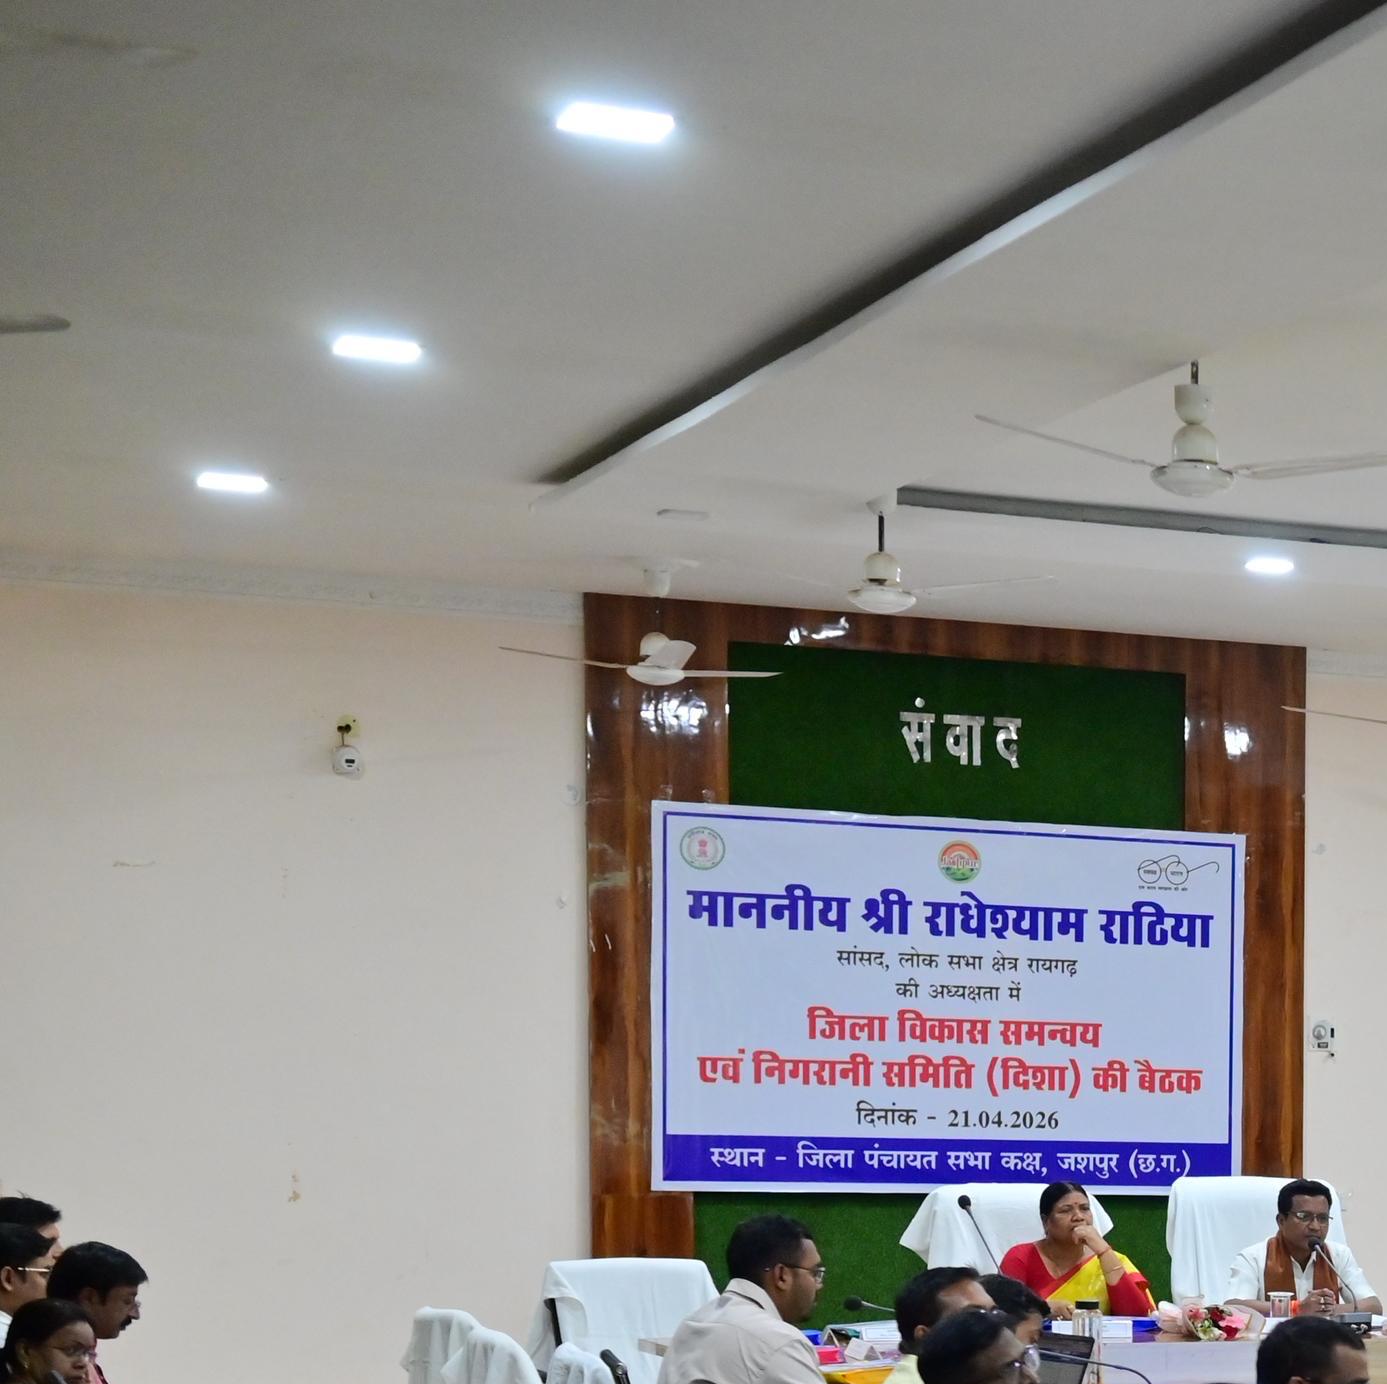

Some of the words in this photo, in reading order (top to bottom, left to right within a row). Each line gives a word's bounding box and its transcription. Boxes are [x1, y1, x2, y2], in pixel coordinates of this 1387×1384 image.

[899, 697, 1022, 769] संवाद
[686, 883, 851, 933] माननीय
[860, 888, 913, 936] श्री
[922, 890, 1089, 943] राधेश्याम
[1097, 900, 1215, 949] राठिया
[836, 946, 890, 971] सांसद,
[897, 948, 940, 969] लोक
[946, 954, 984, 970] सभा
[991, 950, 1020, 973] क्षेत्र
[1026, 957, 1078, 978] रायगढ़
[895, 977, 920, 998] की
[929, 984, 1001, 1003] अध्यक्षता
[1007, 980, 1022, 1002] में
[806, 1005, 889, 1042] जिला
[896, 1008, 992, 1045] विकास
[998, 1020, 1103, 1048] समन्वय
[696, 1048, 746, 1084] एवं
[751, 1050, 874, 1087] निगरानी
[881, 1054, 976, 1089] समिति
[986, 1056, 1081, 1099] (दिशा)
[1091, 1059, 1130, 1093] की
[1133, 1059, 1204, 1095] बैठक
[855, 1099, 918, 1127] दिनांक
[947, 1109, 1059, 1130] 21.04.2026
[709, 1147, 766, 1168] स्थान
[796, 1140, 855, 1169] जिला
[863, 1144, 939, 1170] पंचायत
[946, 1151, 992, 1171] सभा
[1000, 1151, 1048, 1177] कक्ष,
[1056, 1152, 1120, 1179] जशपुर
[1128, 1148, 1191, 1178] (छ.ग.)
